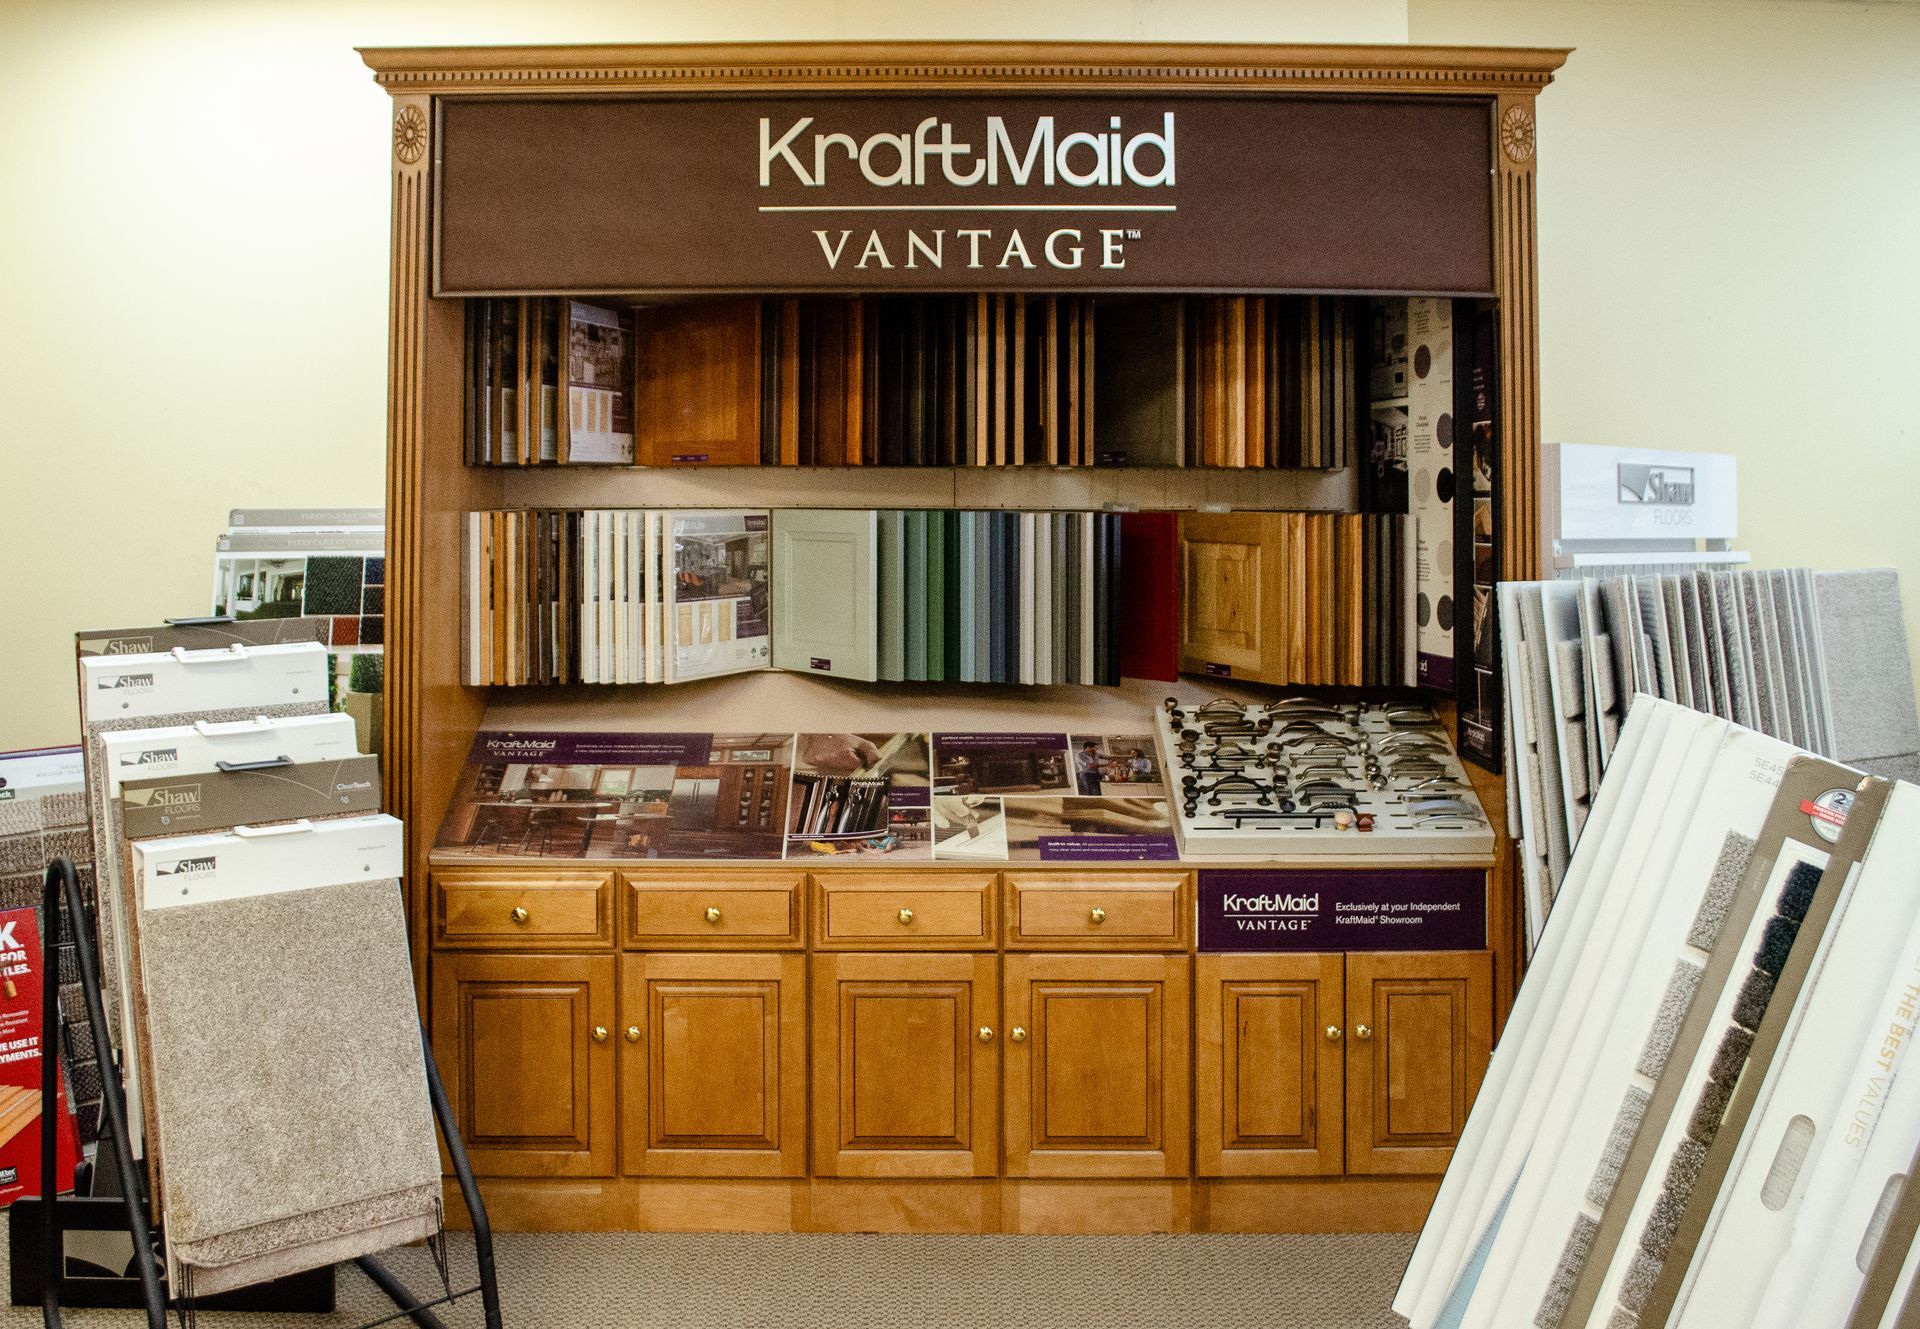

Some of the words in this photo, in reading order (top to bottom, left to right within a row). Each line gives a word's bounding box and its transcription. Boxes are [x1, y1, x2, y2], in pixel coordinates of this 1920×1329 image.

[759, 111, 1176, 187] KraftMaid
[1648, 471, 1695, 504] Shaw
[1654, 509, 1693, 526] FLOORS
[109, 640, 151, 655] Shaw
[119, 675, 153, 688] Shaw
[487, 740, 556, 749] KraftMaid
[142, 751, 177, 764] Shaw
[153, 789, 198, 806] Shaw
[164, 802, 201, 815] FLOORS
[179, 859, 216, 873] Shaw
[1223, 893, 1319, 911] KraftMaid
[1335, 902, 1380, 913] Exclusively
[1381, 903, 1390, 911] at
[1390, 904, 1409, 913] your
[1410, 902, 1461, 913] Independent
[1380, 915, 1423, 924] Showroom
[1896, 983, 1920, 1021] THE
[9, 1039, 29, 1050] USE
[29, 1036, 39, 1047] IT
[1876, 1023, 1906, 1073] BEST
[1845, 1076, 1886, 1149] VALUES
